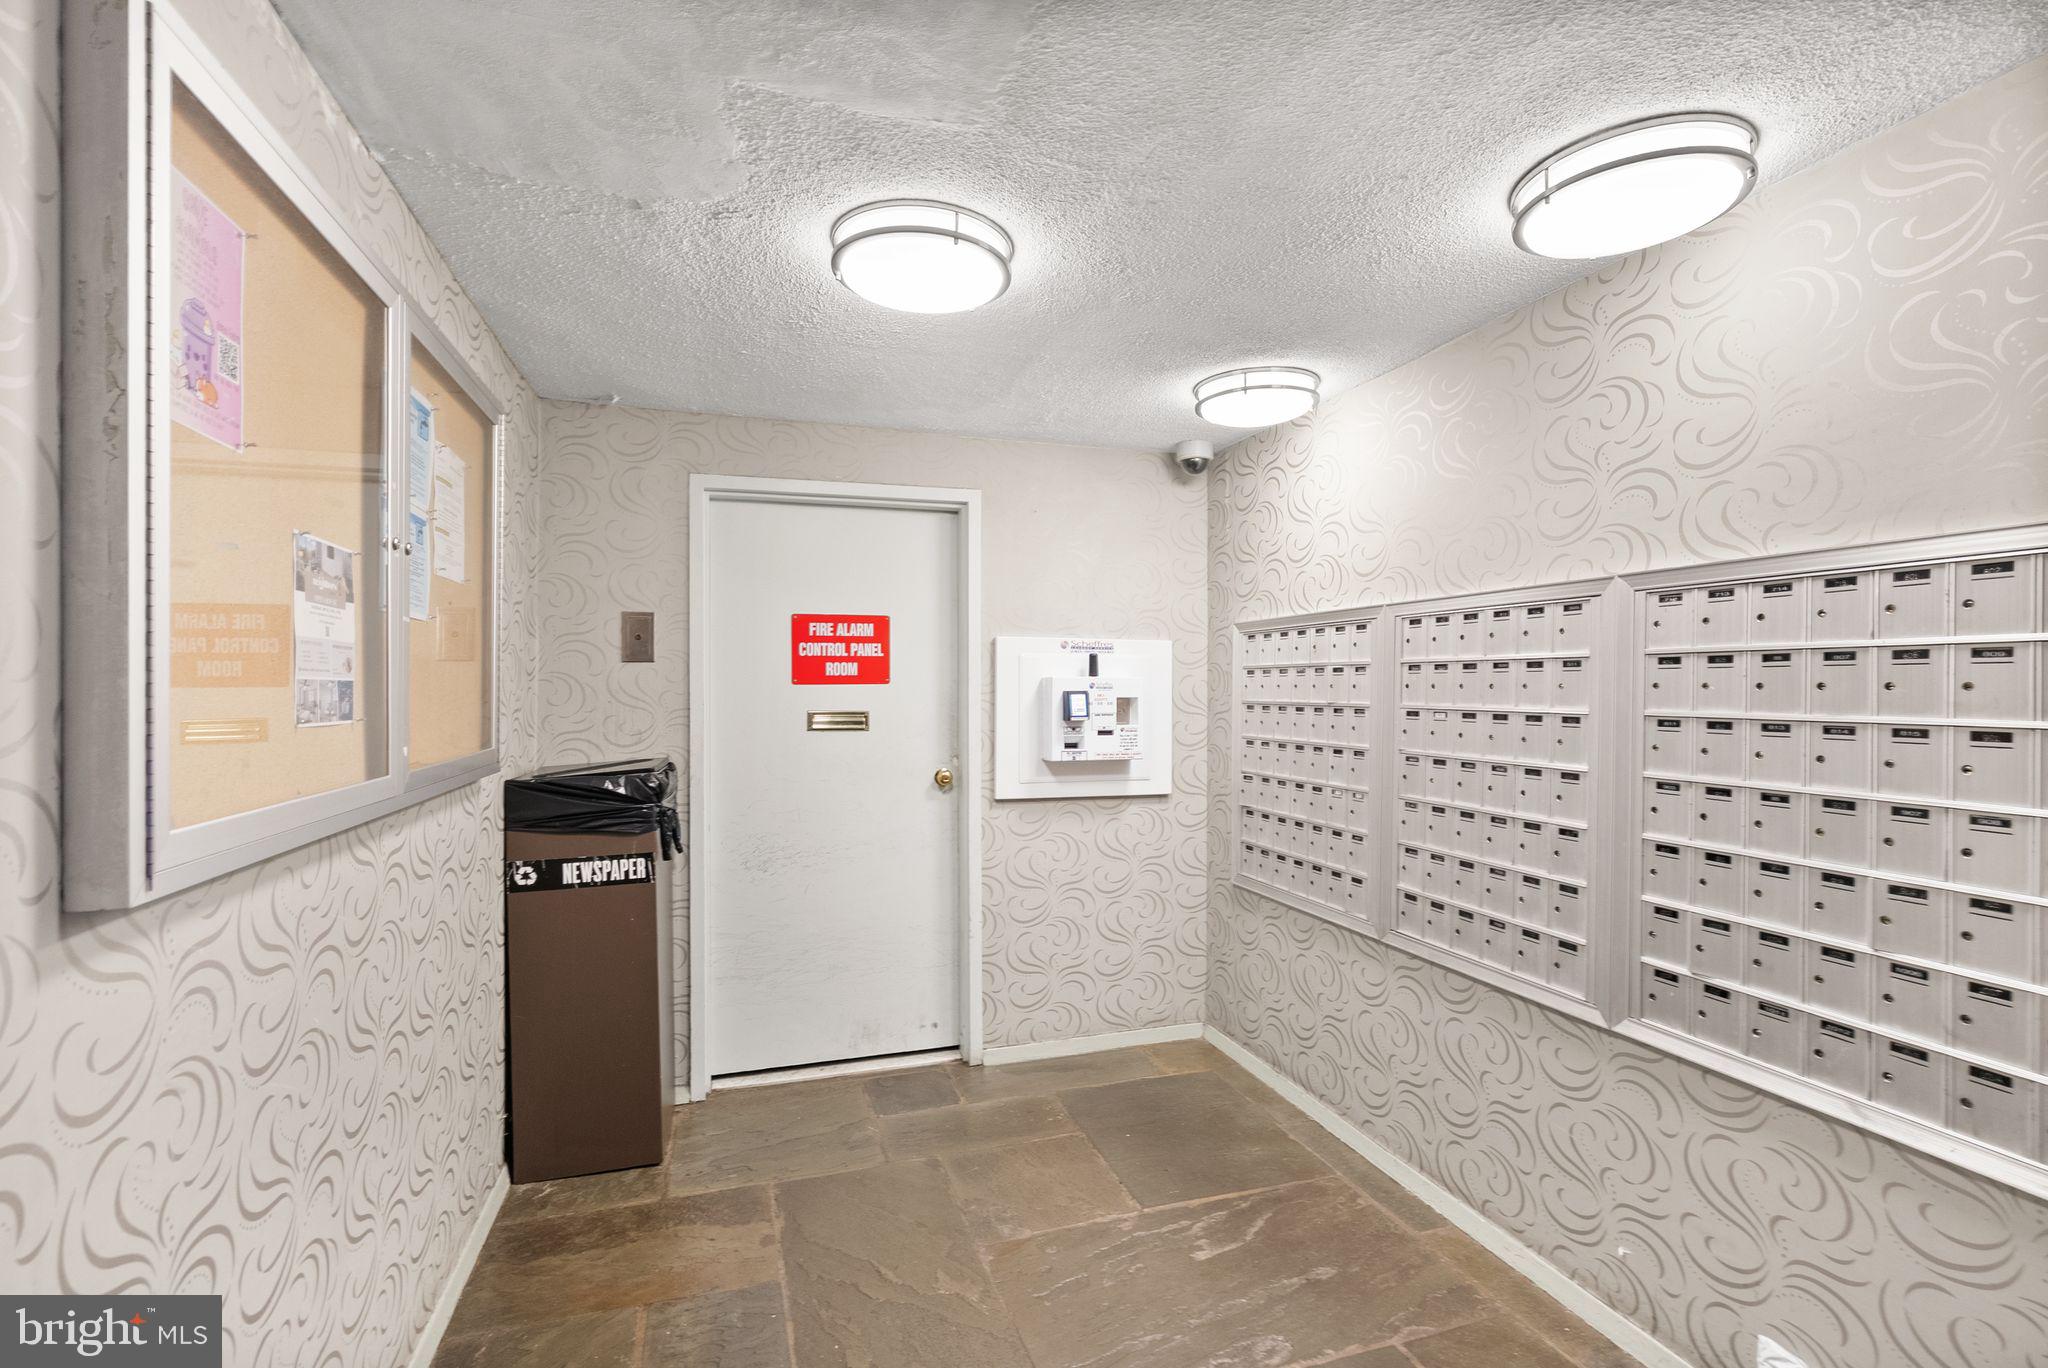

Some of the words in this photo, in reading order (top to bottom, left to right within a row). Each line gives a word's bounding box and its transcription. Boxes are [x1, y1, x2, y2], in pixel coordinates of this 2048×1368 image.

[808, 622, 834, 636] FIRE
[836, 622, 874, 637] ALARM
[798, 642, 848, 657] CONTROL
[850, 643, 884, 657] PANEL
[825, 662, 858, 676] ROOM
[561, 857, 647, 885] NEWSPAPER
